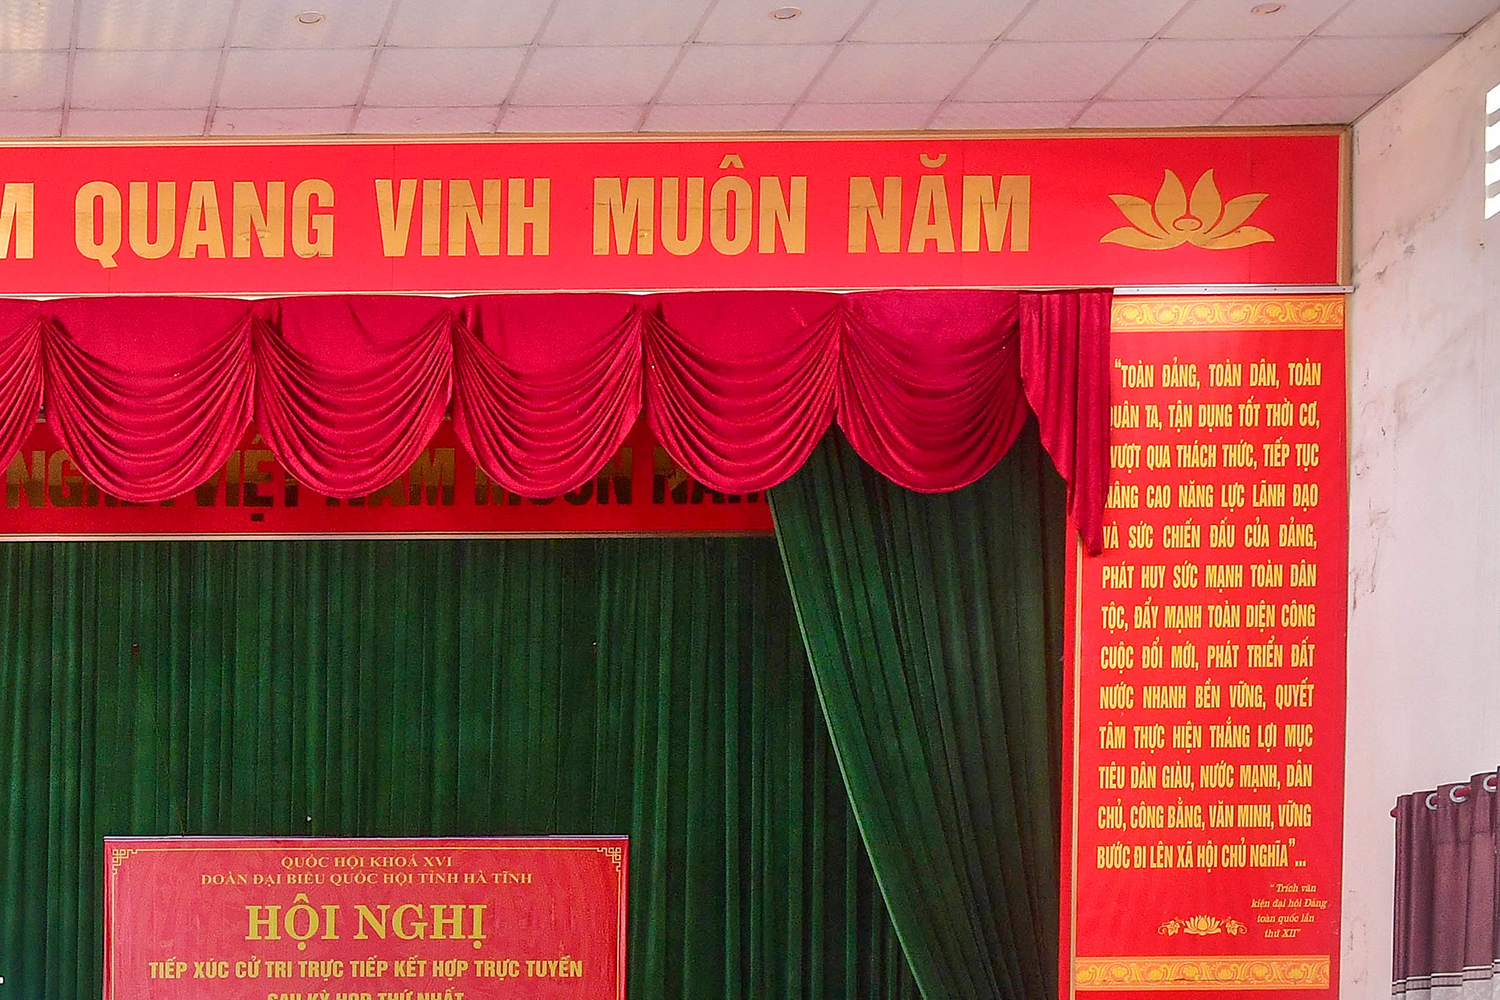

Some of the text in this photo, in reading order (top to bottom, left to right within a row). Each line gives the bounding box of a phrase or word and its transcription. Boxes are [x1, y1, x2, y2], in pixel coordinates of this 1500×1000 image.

[76, 179, 334, 269] QUANG
[375, 179, 550, 256] VINH
[593, 154, 807, 255] MUÔN
[849, 154, 1031, 253] NĂM
[1162, 357, 1200, 390] ĐẢNG,
[1209, 359, 1241, 387] TOÀN
[1250, 359, 1279, 389] DÂN,
[1288, 358, 1321, 386] TOÀN
[1111, 396, 1319, 432] UÂN TA, TẬN DỤNG TỐT THỜI CƠ,
[1103, 517, 1316, 549] VÀ SỨC CHIẾN ĐẤU CỦA ĐẢNG,
[1102, 559, 1316, 593] PHÁT HUY SỨC MẠNH TOÀN DÂN
[1100, 677, 1314, 710] NƯỚC NHANH BỀN VỮNG, QUYẾT
[1099, 717, 1313, 753] TÂM THỰC HIỆN THẮNG LỢI MỤC
[1097, 841, 1130, 868] BƯỚC
[1134, 846, 1146, 868] ĐI
[1150, 841, 1173, 868] LÊN
[1177, 841, 1193, 867] XÃ
[1197, 840, 1217, 872] HỘI
[1222, 837, 1246, 867] CHỦ
[245, 893, 487, 950] HỘI NGHỊ
[149, 955, 582, 981] TIẾP XÚC CỬ TRI TRỰC TIẾP KẾT HỢP TRỰC TUYẾN
